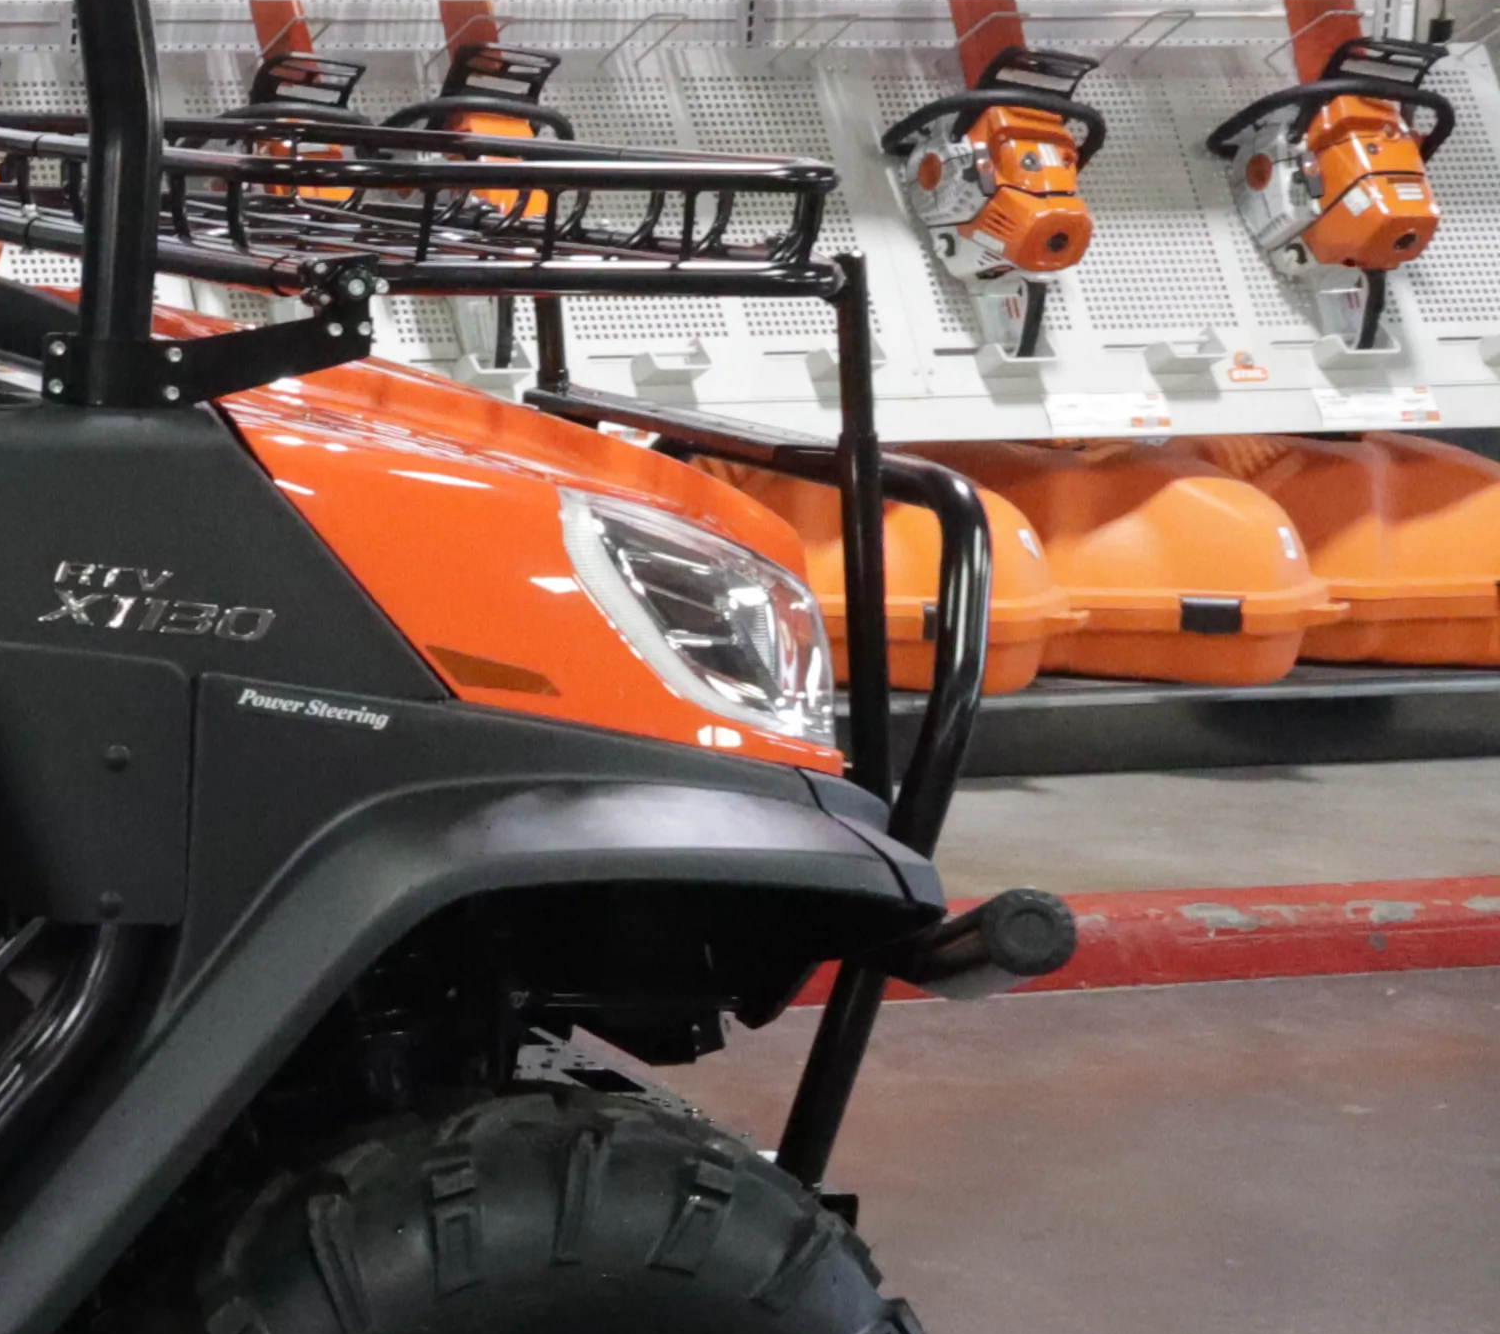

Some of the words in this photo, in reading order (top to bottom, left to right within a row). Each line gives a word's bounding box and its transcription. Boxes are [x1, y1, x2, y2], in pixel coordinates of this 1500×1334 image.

[54, 560, 174, 593] RTV
[238, 688, 304, 714] Power
[304, 698, 390, 730] Steering
